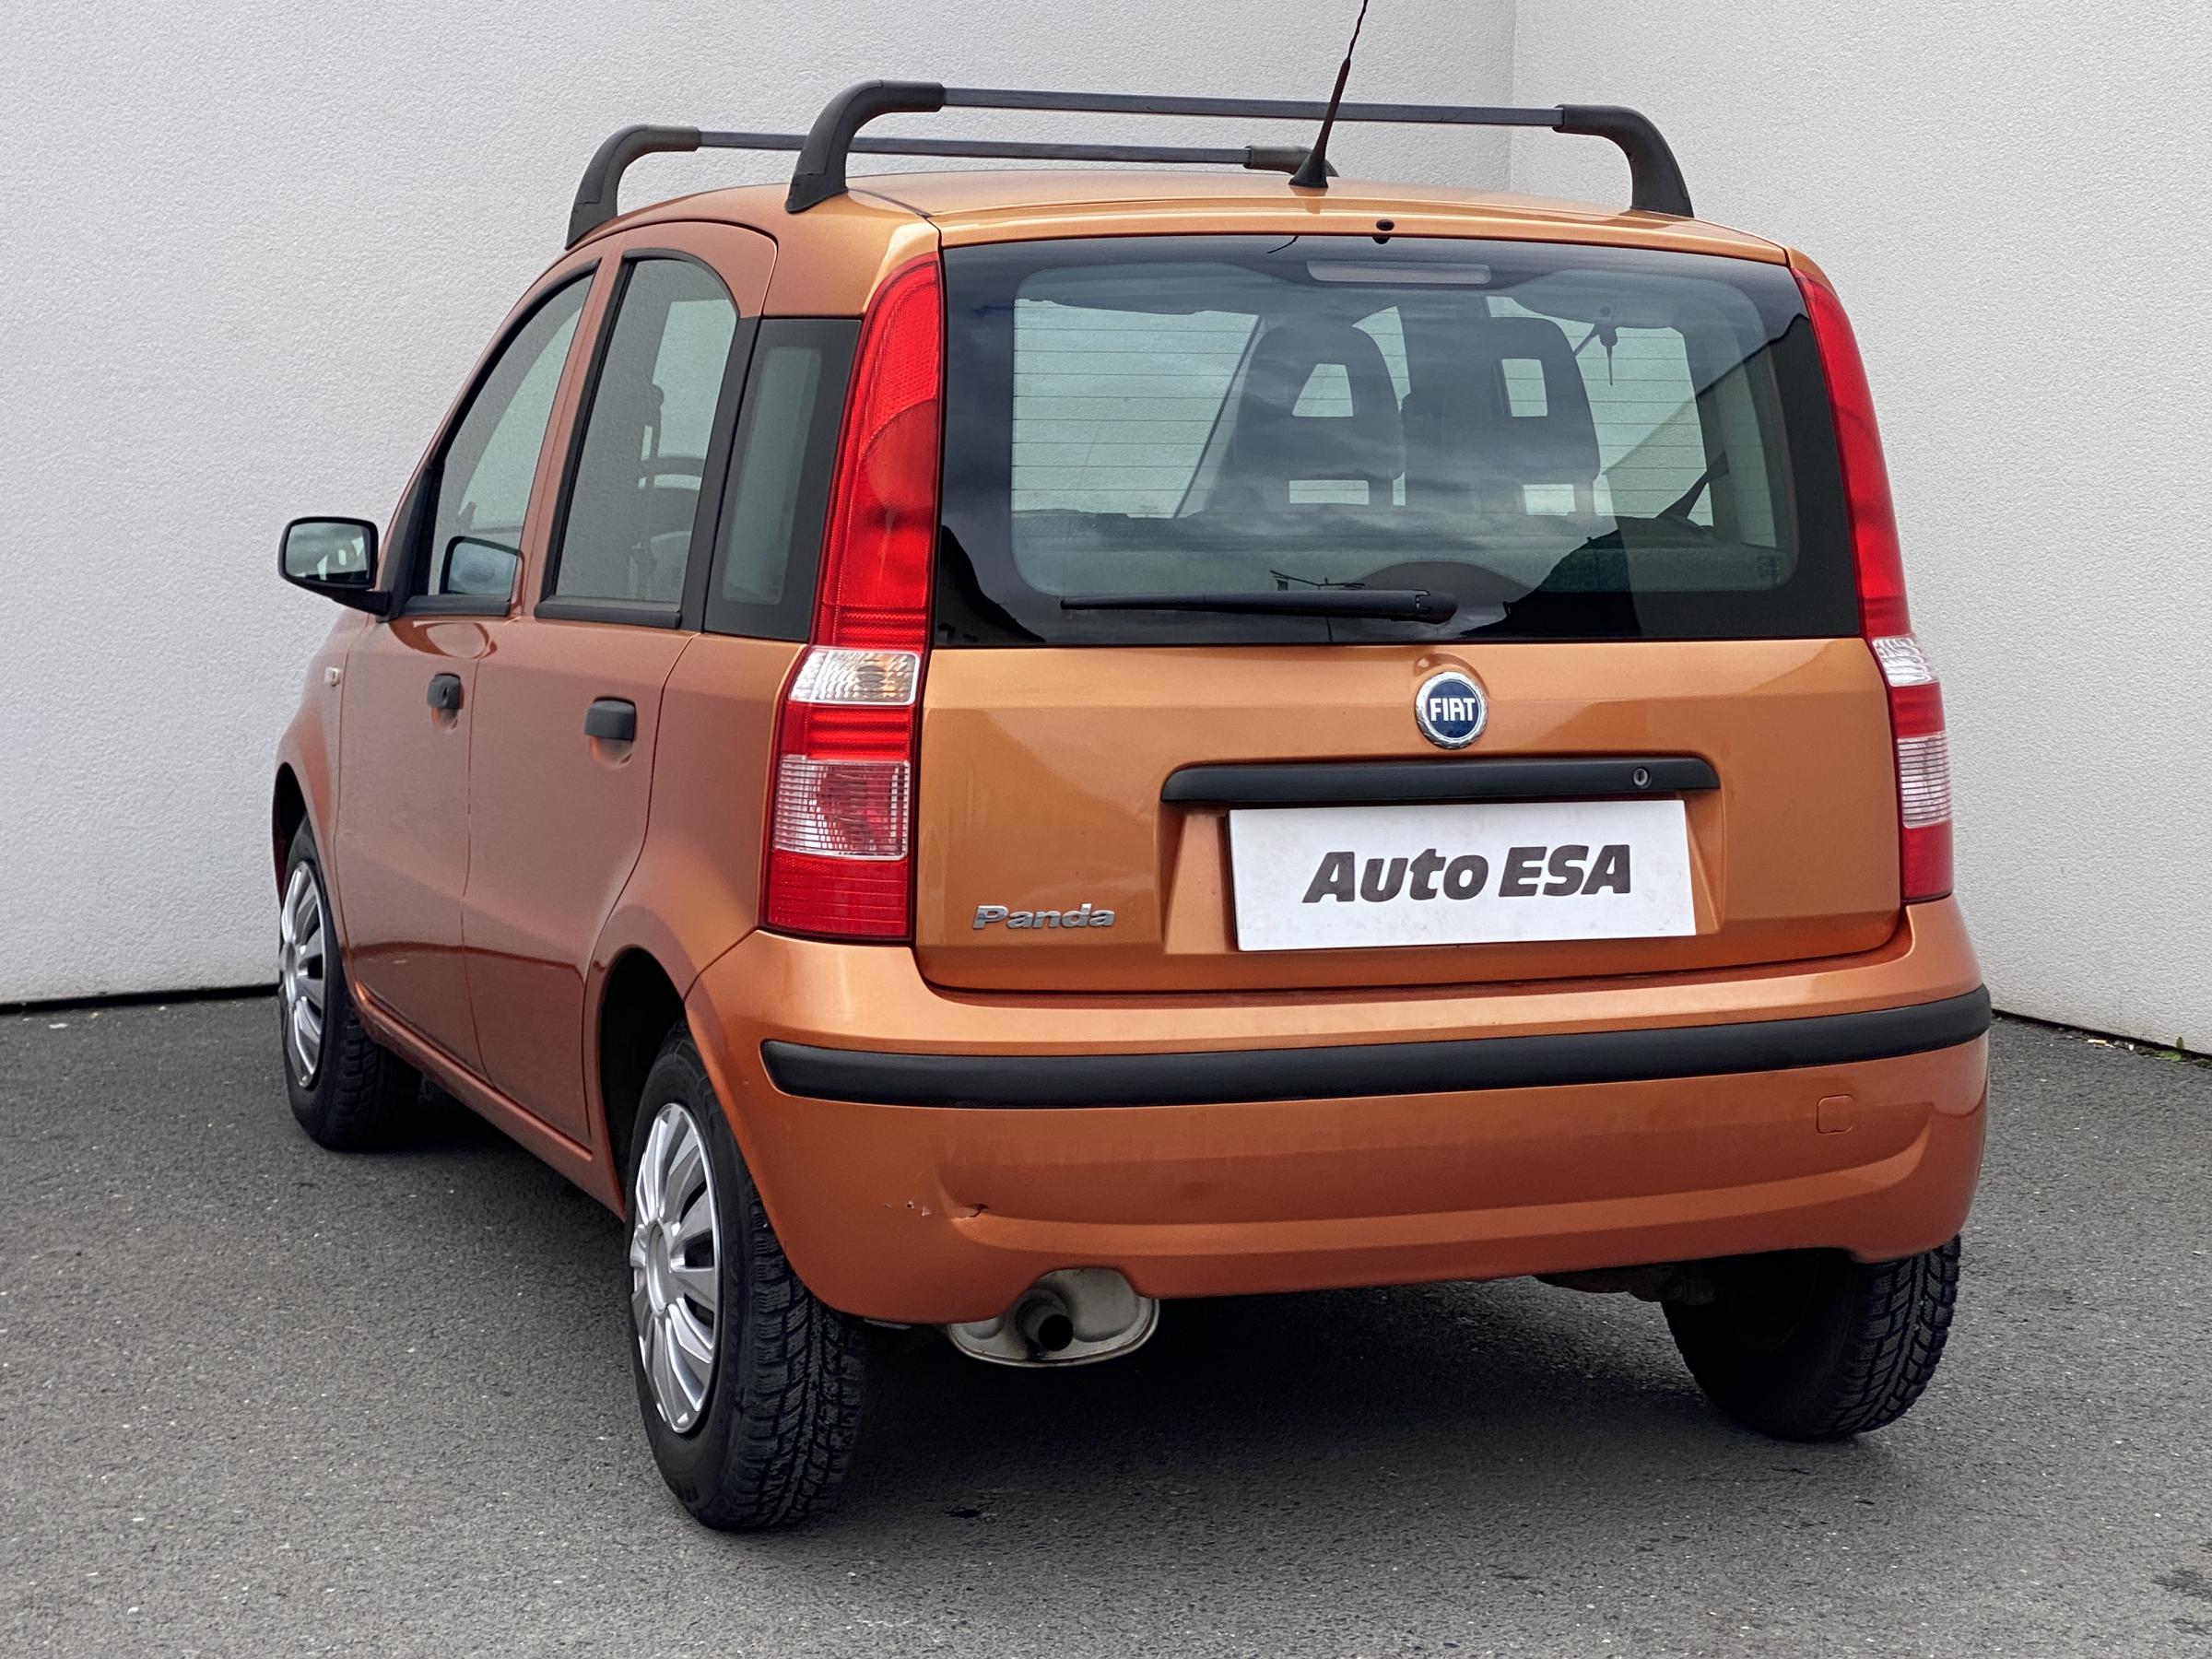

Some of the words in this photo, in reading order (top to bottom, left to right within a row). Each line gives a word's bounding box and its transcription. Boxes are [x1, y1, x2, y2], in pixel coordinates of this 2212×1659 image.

[1430, 698, 1476, 722] FIAT
[1302, 849, 1489, 903] Auto
[1499, 844, 1631, 897] ESA
[972, 903, 1115, 930] Panda
